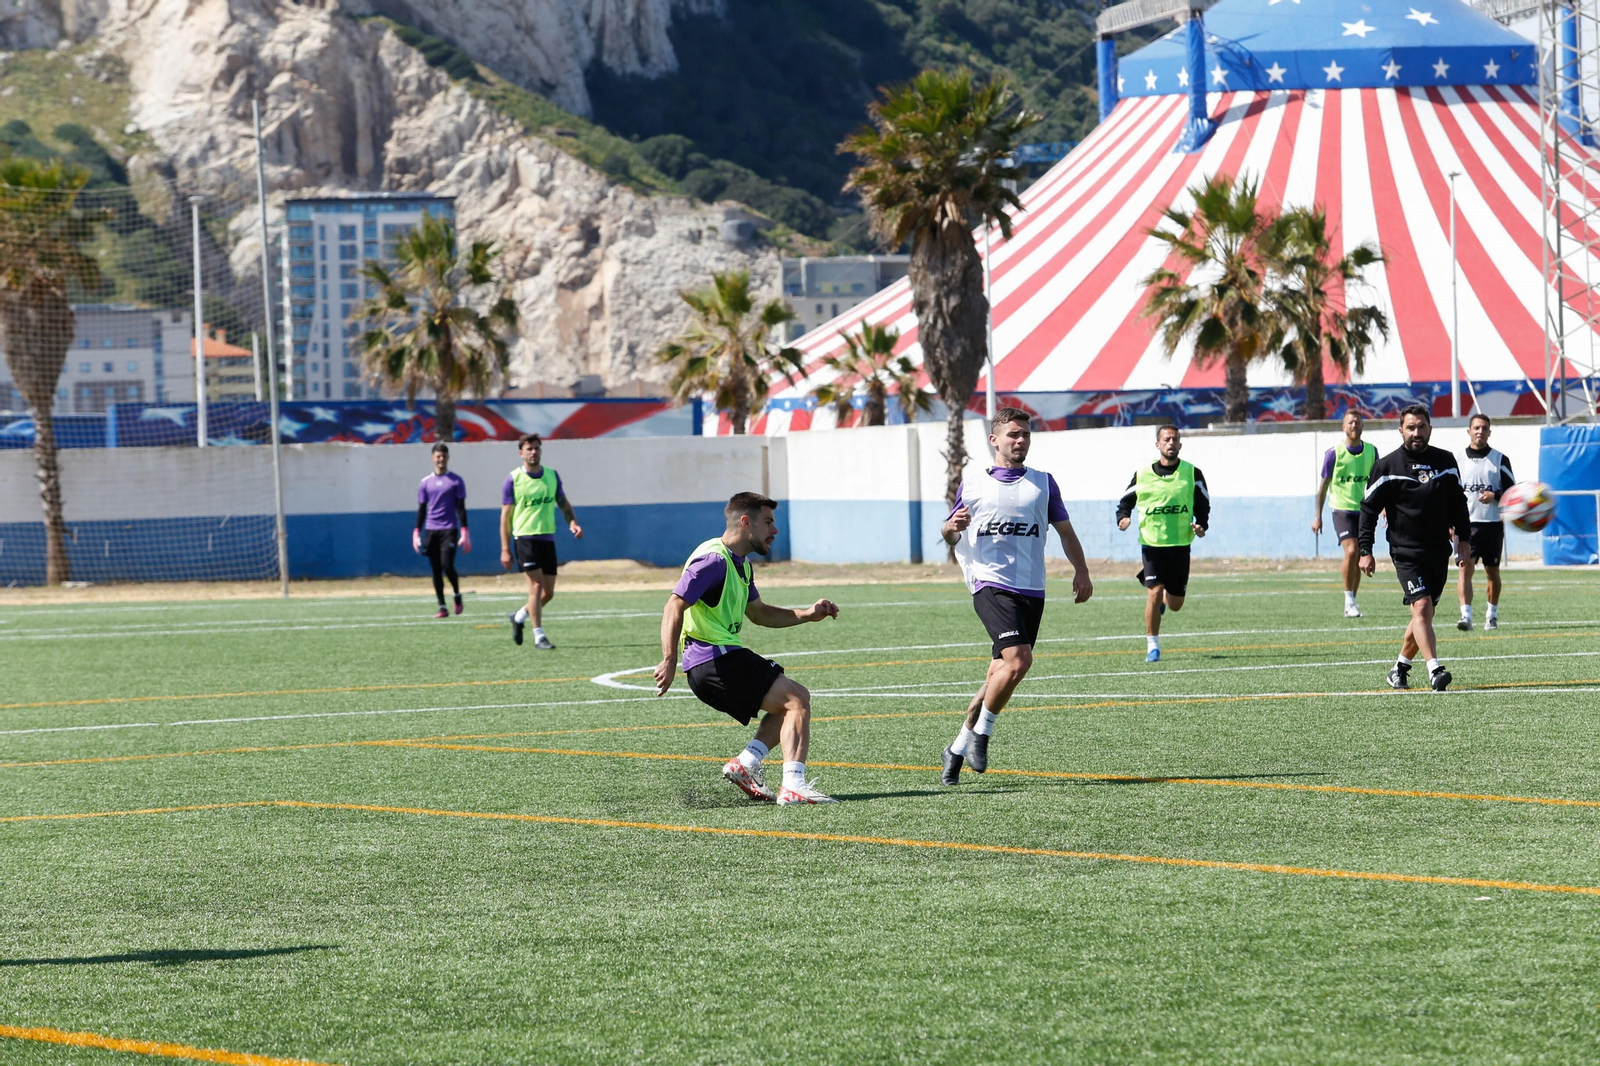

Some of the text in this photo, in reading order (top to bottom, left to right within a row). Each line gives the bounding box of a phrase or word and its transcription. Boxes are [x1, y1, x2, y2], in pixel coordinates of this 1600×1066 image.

[1463, 484, 1493, 492] EGEA
[1145, 505, 1189, 516] LEGEA
[977, 521, 1040, 538] LEGEA
